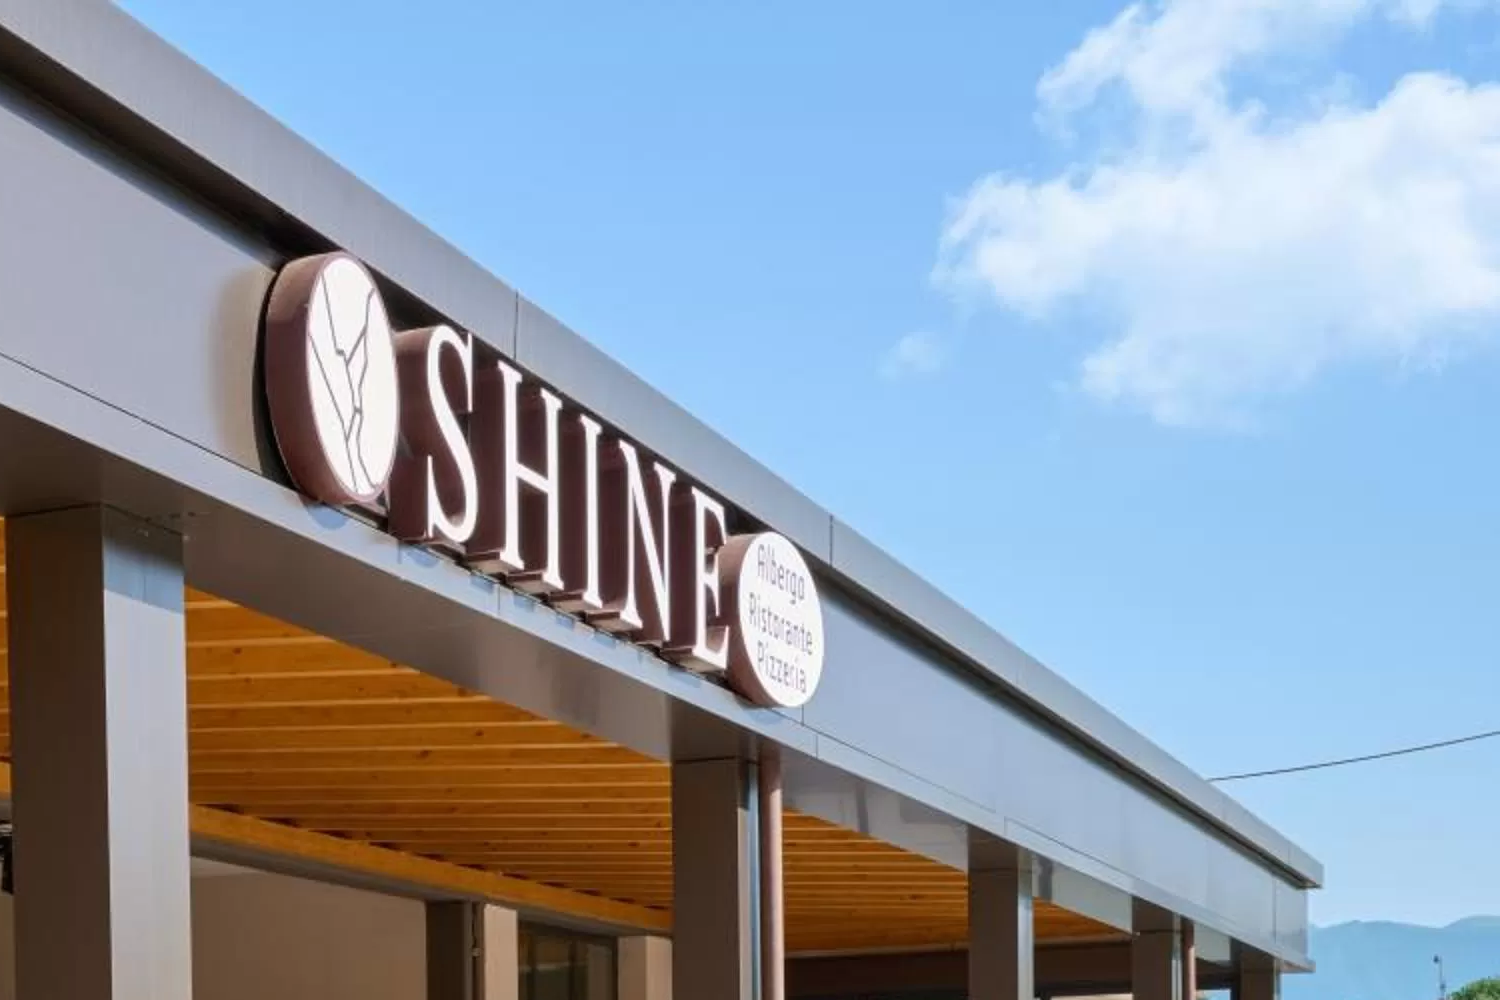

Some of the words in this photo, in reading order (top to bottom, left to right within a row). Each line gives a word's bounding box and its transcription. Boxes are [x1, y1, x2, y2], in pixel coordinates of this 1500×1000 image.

[426, 325, 731, 670] SHINE
[757, 544, 805, 605] Albergo
[750, 592, 813, 655] Ristorante
[757, 640, 806, 693] Pizzeria
